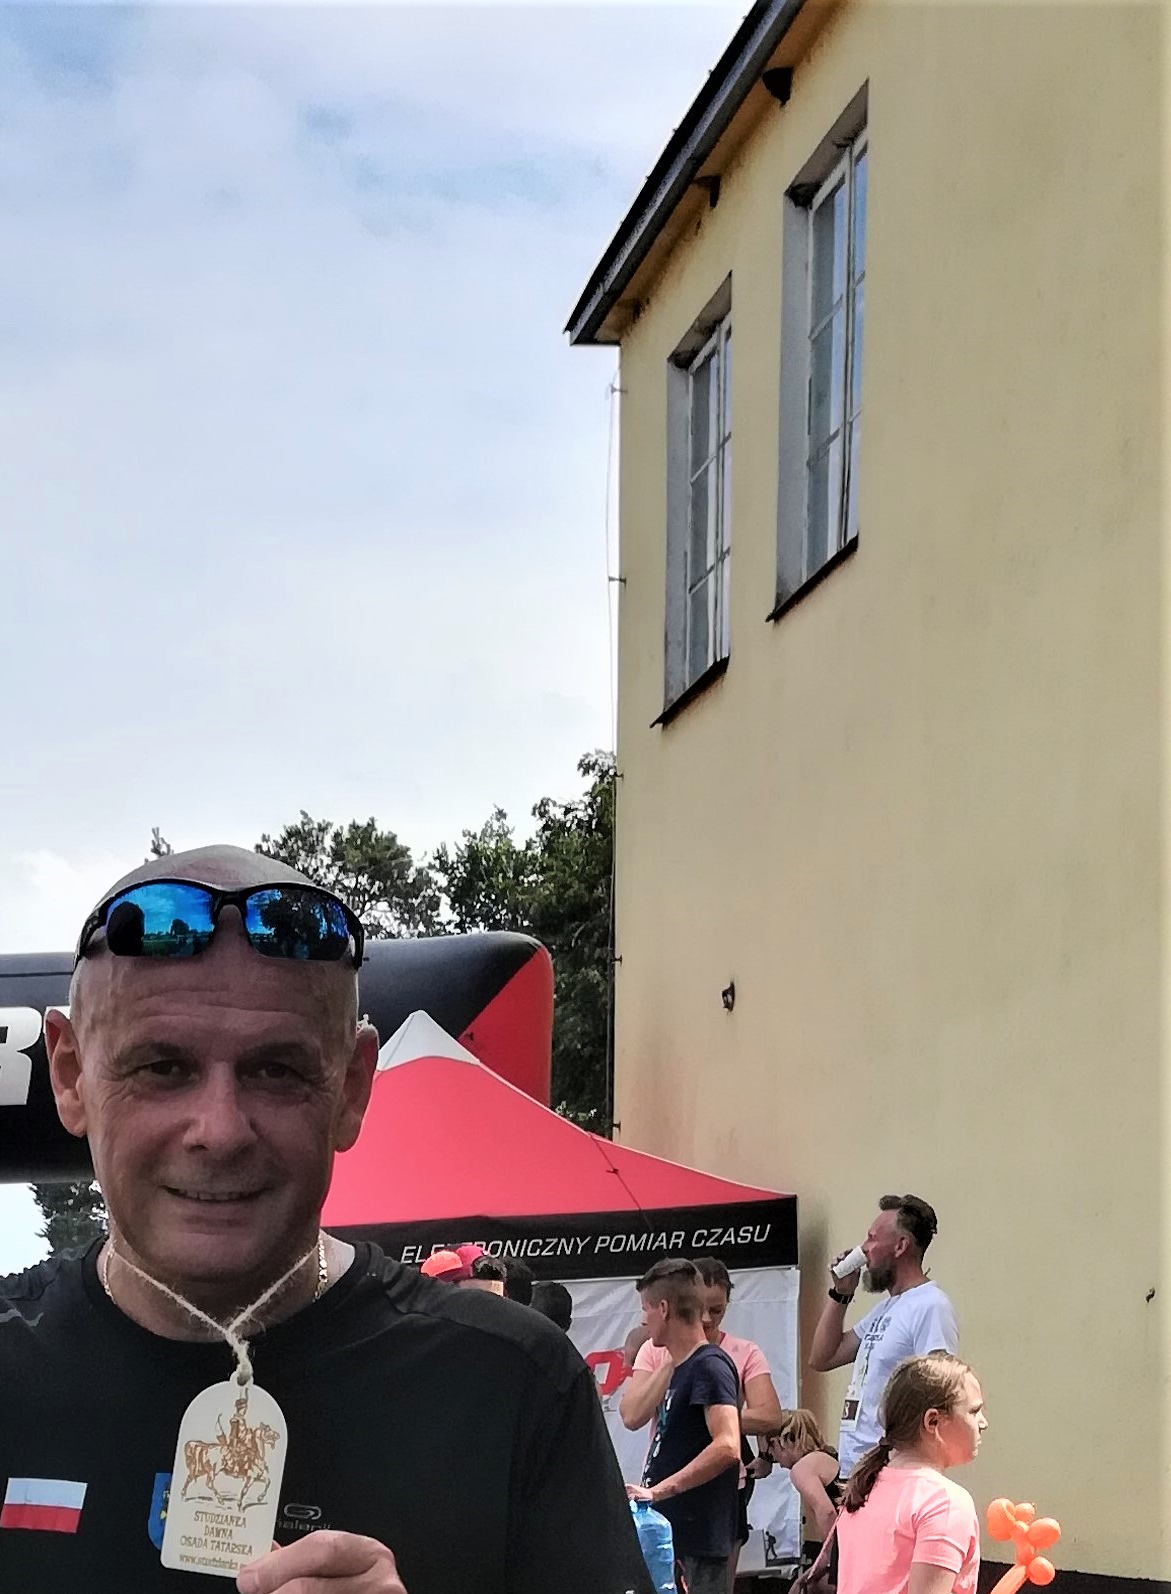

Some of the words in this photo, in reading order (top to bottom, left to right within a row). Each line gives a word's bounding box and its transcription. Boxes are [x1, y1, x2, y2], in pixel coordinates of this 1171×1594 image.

[400, 1235, 591, 1264] ELRONICZNY
[594, 1231, 686, 1254] POMIAR
[691, 1223, 772, 1248] CZASU
[204, 1525, 233, 1540] DAWNA
[180, 1535, 208, 1549] OSADA
[211, 1540, 253, 1556] TATARSKA
